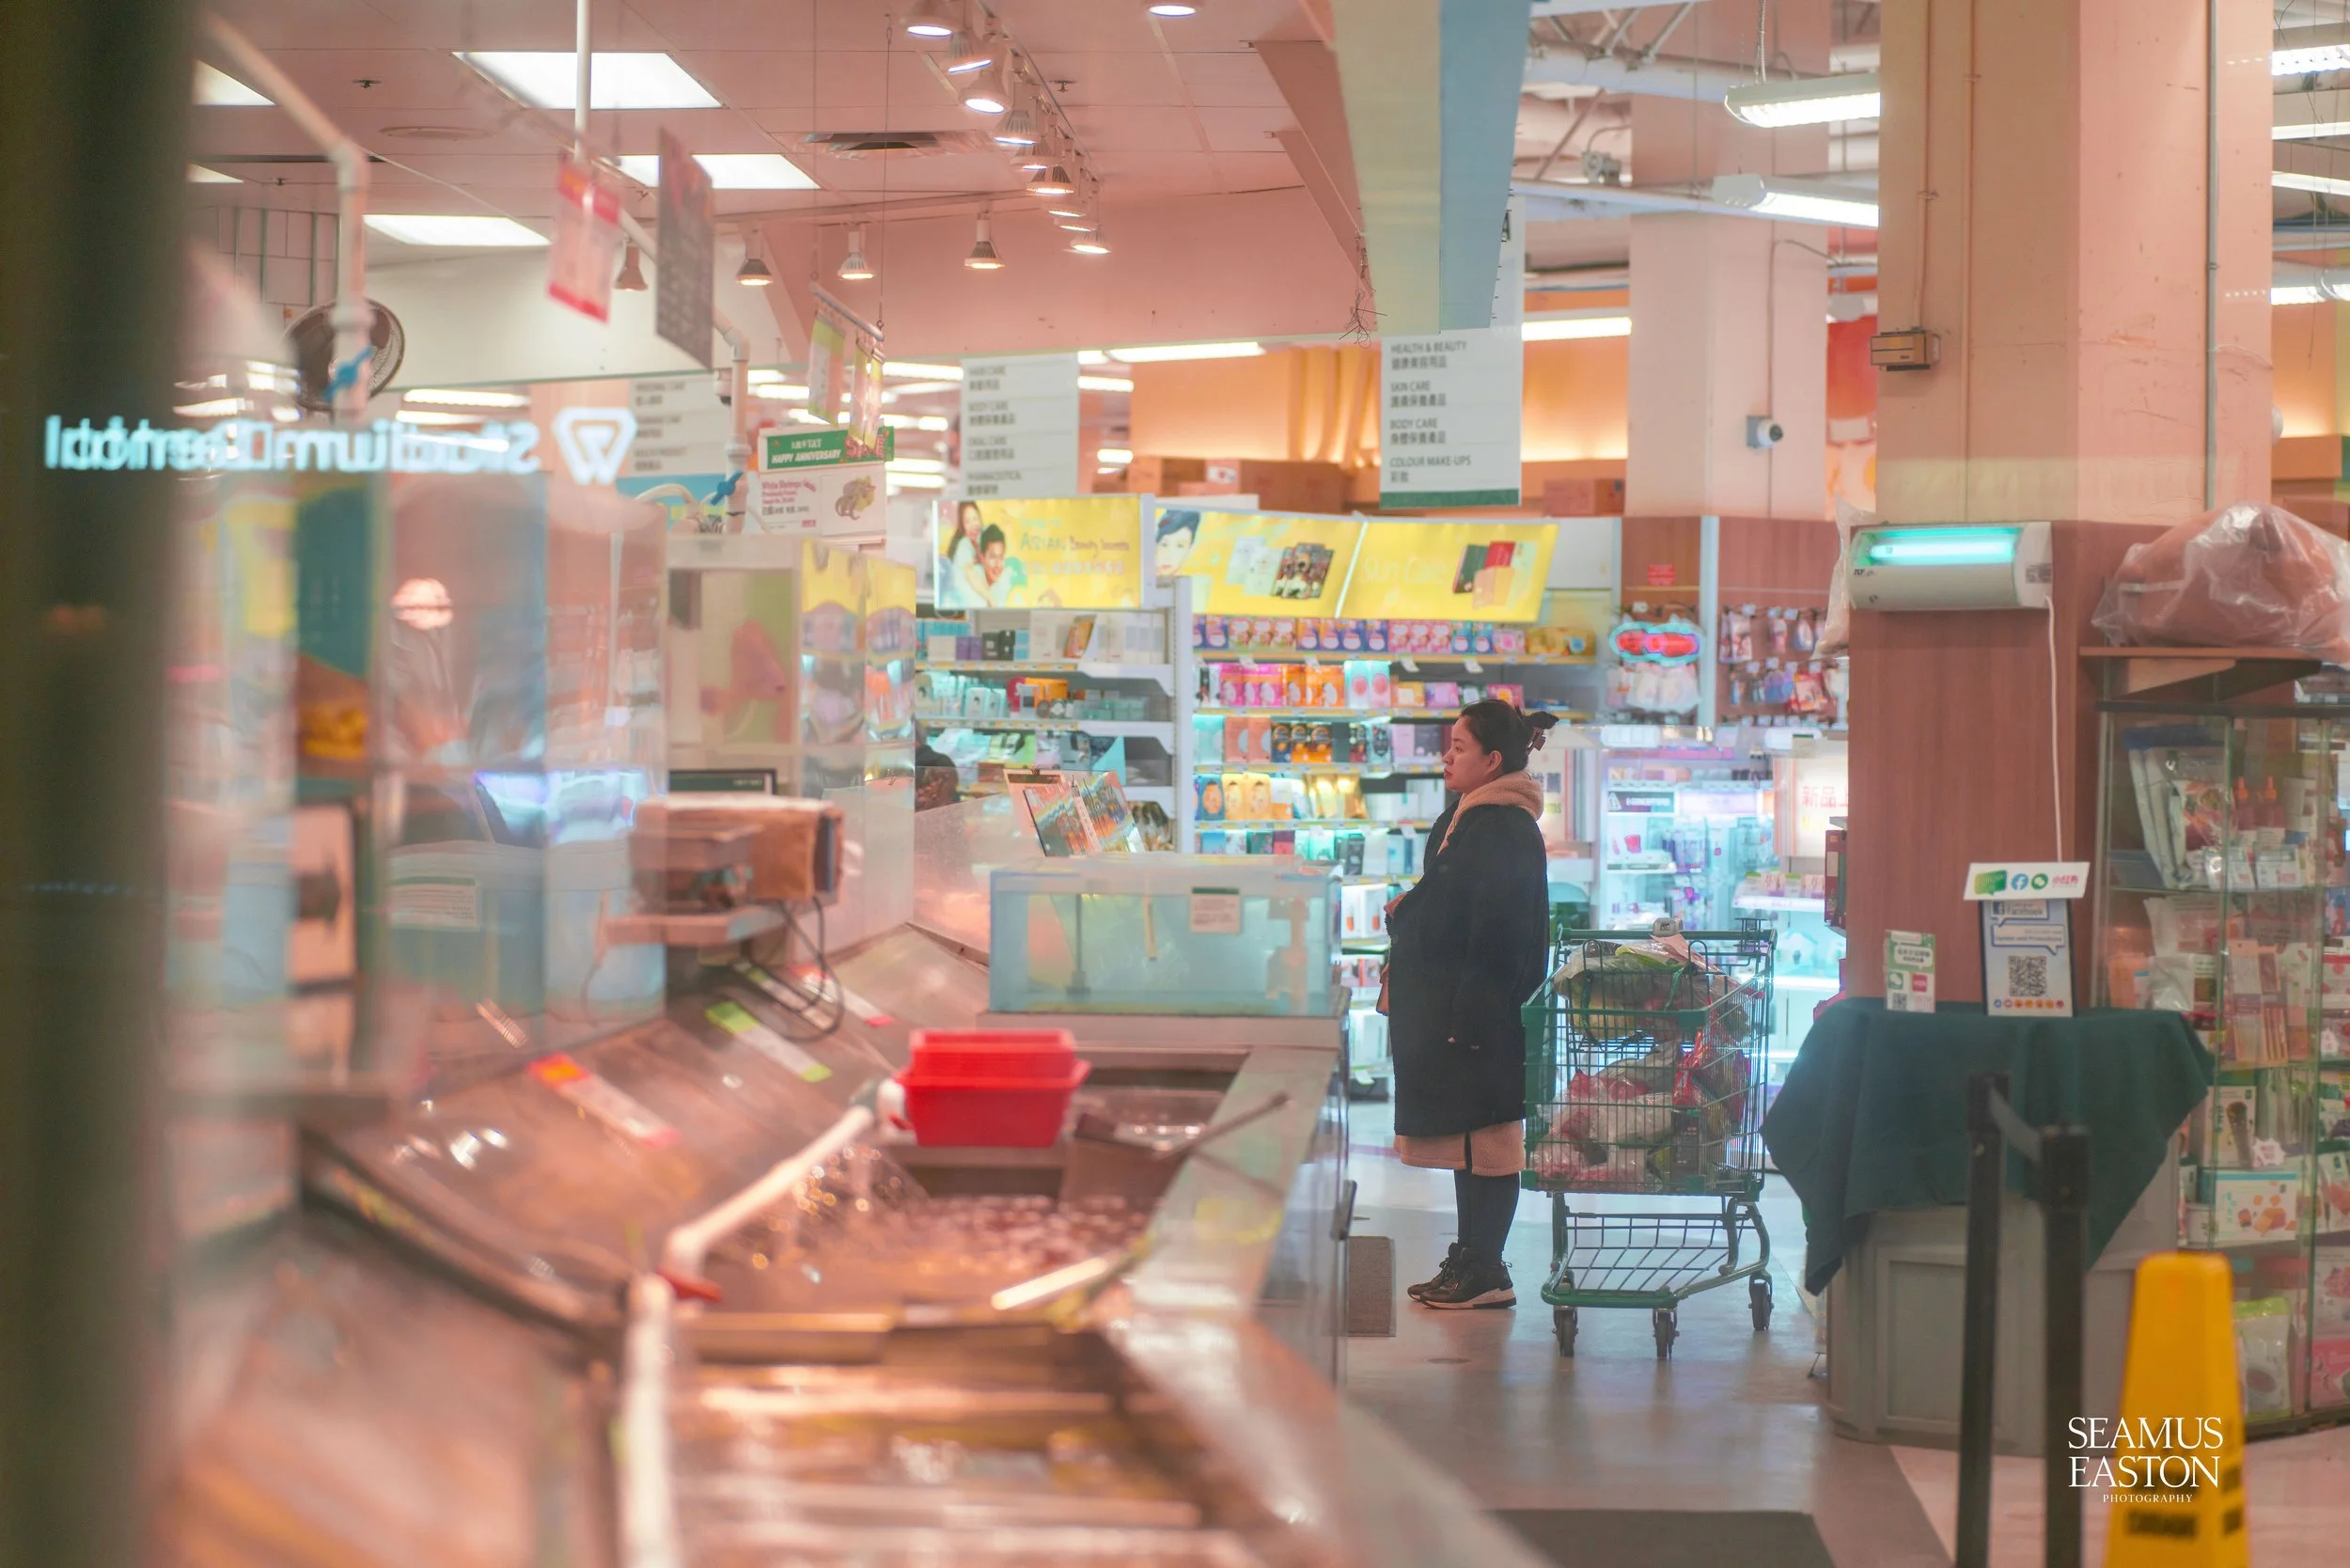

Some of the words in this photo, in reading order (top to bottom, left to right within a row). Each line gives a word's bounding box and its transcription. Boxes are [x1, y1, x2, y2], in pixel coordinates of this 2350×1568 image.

[1390, 343, 1423, 354] HEALTH
[1434, 339, 1467, 353] BEAUTY
[1390, 382, 1408, 392] SKIN
[1410, 380, 1431, 392] CARE
[1389, 418, 1414, 430] BODY
[1416, 417, 1438, 429] CARE
[771, 453, 795, 463] HAPPY
[794, 449, 842, 462] ANNIVERSARY
[1389, 456, 1425, 468] COLOUR
